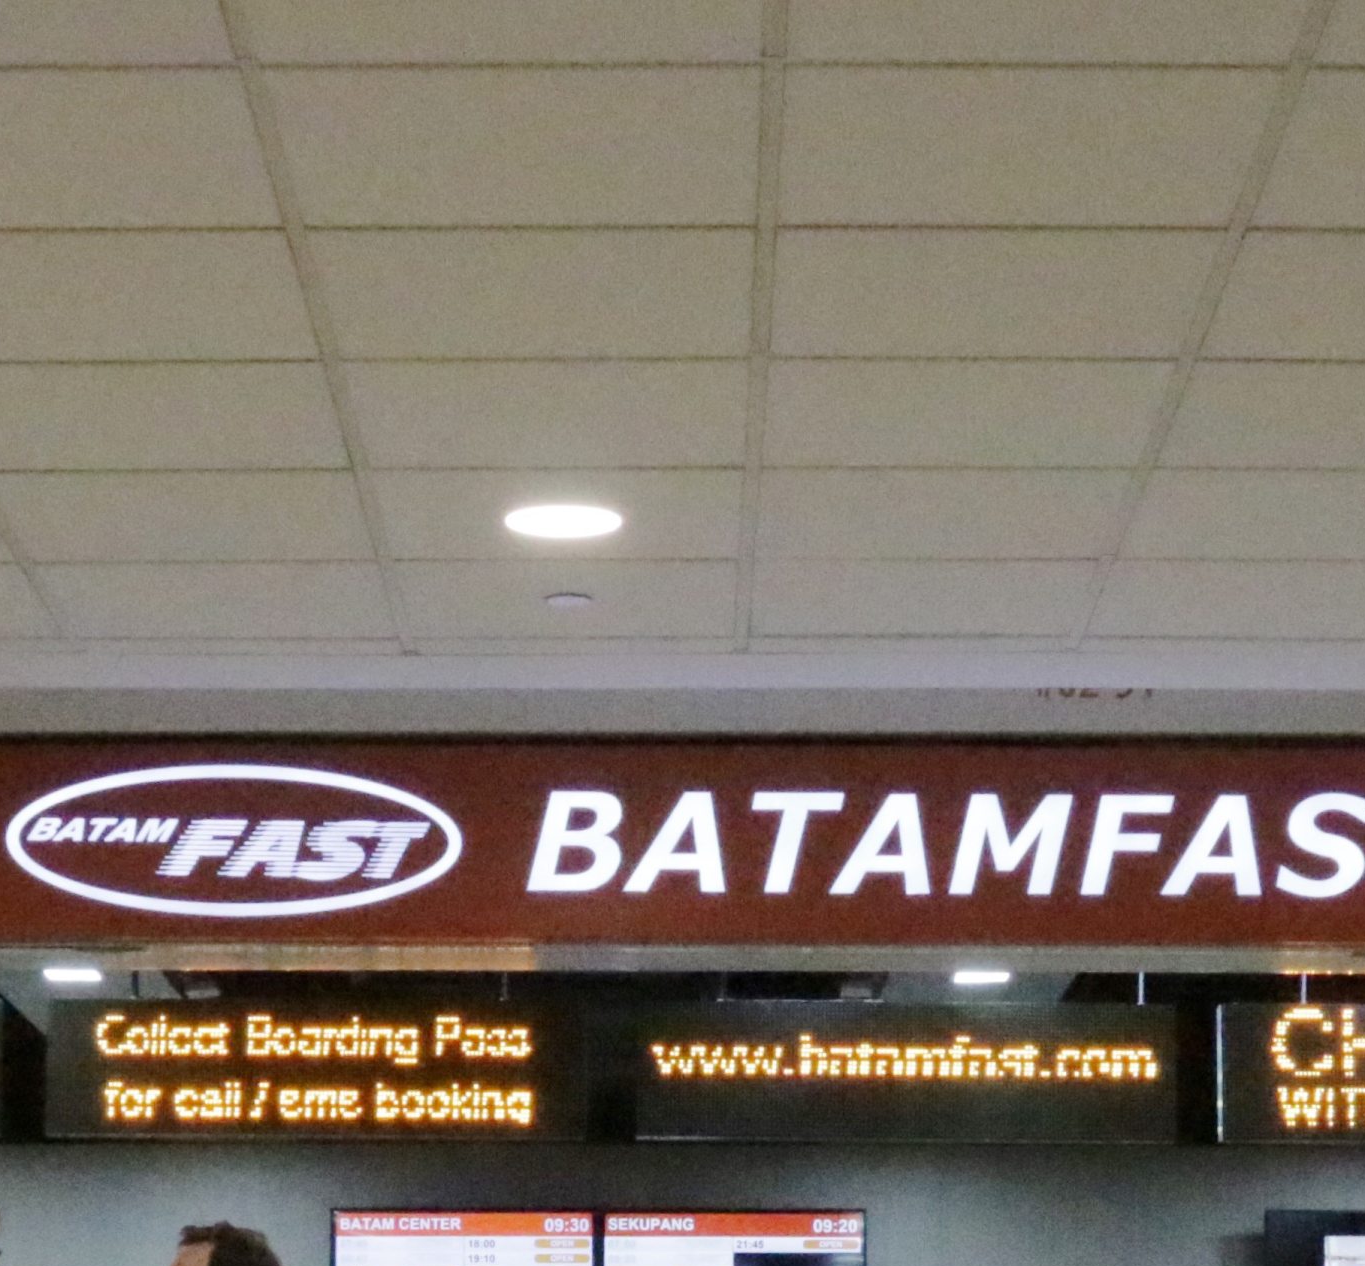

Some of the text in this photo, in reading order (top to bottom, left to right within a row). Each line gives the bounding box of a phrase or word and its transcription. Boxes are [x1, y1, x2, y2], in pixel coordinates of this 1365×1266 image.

[26, 817, 180, 844] BATAM
[155, 818, 431, 882] FAST
[247, 1015, 420, 1065] Boarding
[652, 1035, 1159, 1079] www.batamfast.com
[104, 1081, 163, 1119] for
[174, 1081, 242, 1120] call
[376, 1083, 533, 1126] booking
[339, 1217, 590, 1234] BATAM CENTER 09:30
[608, 1217, 859, 1235] SEKUPANG 09:20
